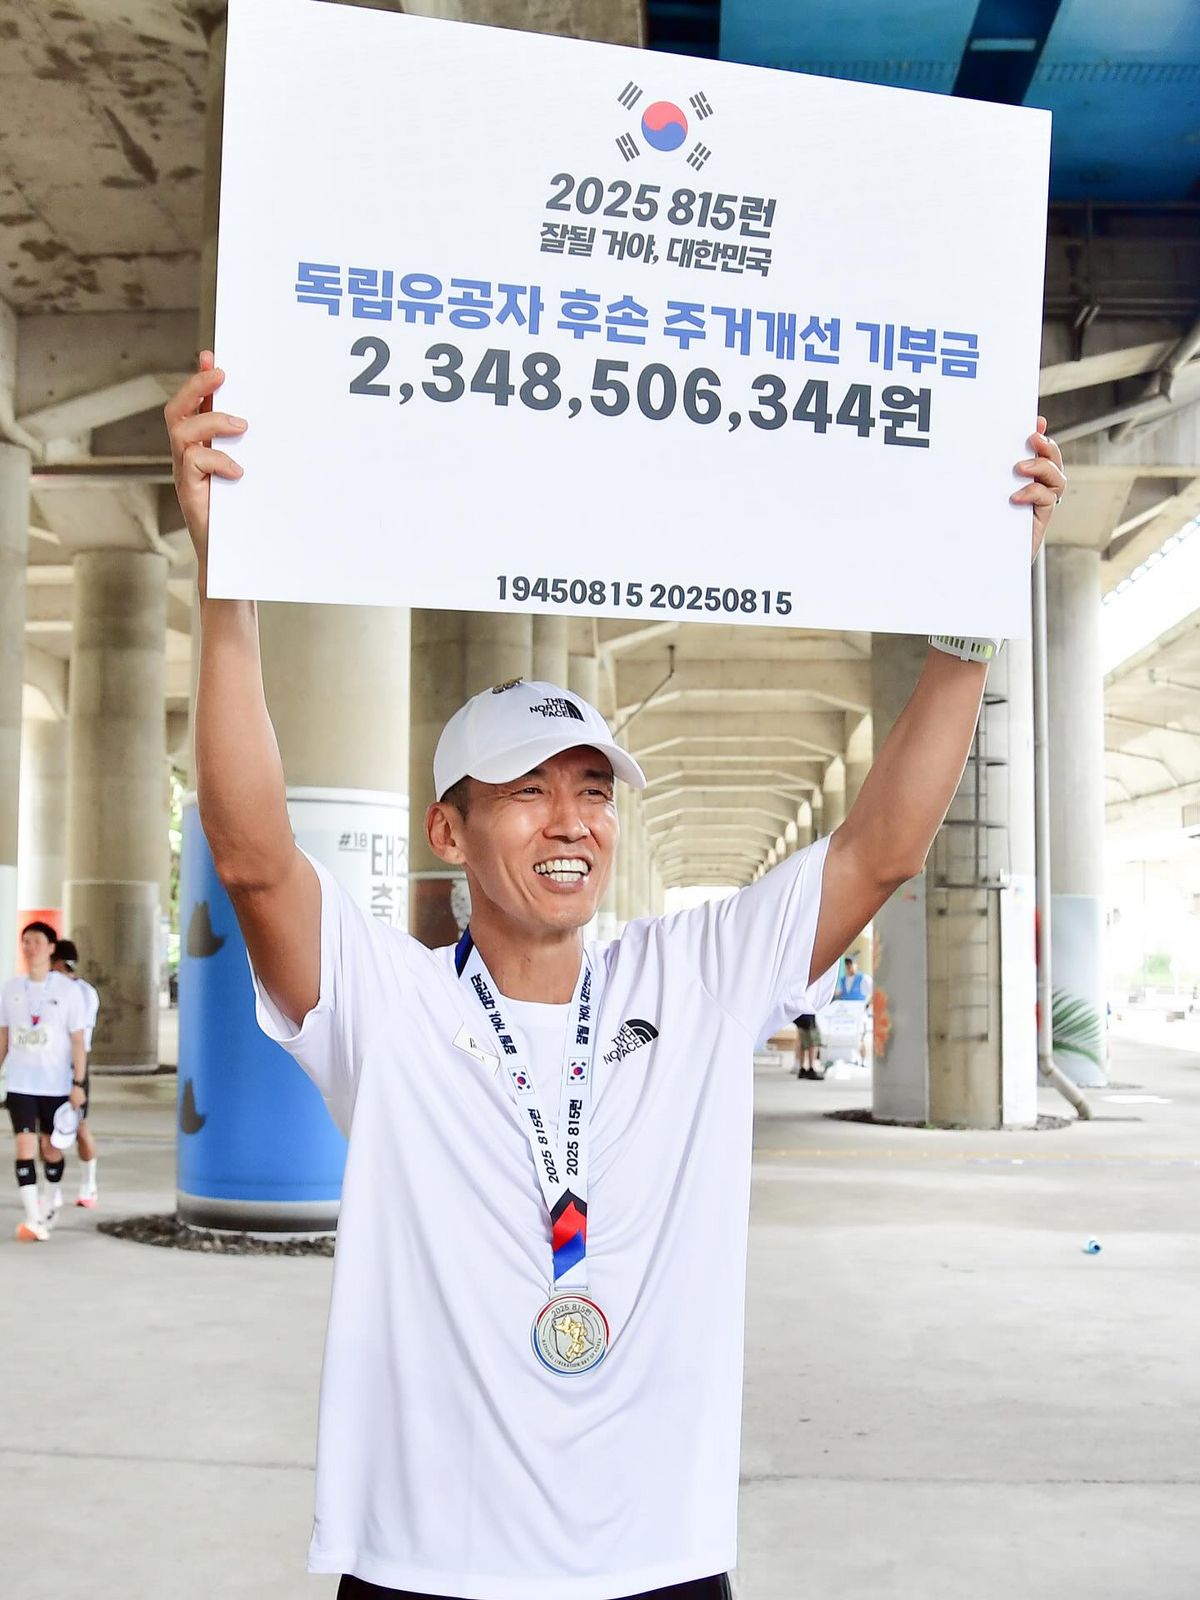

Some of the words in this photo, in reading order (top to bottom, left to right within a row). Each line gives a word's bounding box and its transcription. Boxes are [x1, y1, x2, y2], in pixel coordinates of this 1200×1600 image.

[546, 173, 661, 222] 2025
[667, 189, 777, 240] 815런
[539, 222, 597, 258] 잘될
[601, 230, 661, 265] 거야,
[666, 237, 773, 278] 대한민국
[294, 261, 545, 336] 독립유공자
[557, 288, 649, 346] 후손
[663, 300, 841, 366] 주거개선
[855, 321, 980, 380] 기부금
[349, 335, 932, 449] 2,348,506,344원
[496, 575, 643, 608] 19450815
[650, 583, 793, 616] 20250815
[529, 703, 567, 713] NORTH
[542, 710, 569, 718] FACE
[543, 698, 565, 706] THE
[339, 832, 368, 847] #18
[470, 973, 496, 1010] 대한민국
[498, 1034, 517, 1055] 잘될
[576, 1024, 590, 1045] 잘될
[528, 1108, 548, 1145] 815런
[568, 1099, 582, 1136] 815런
[541, 1150, 560, 1184] 2025
[566, 1141, 579, 1176] 2025
[551, 1304, 570, 1317] 2025
